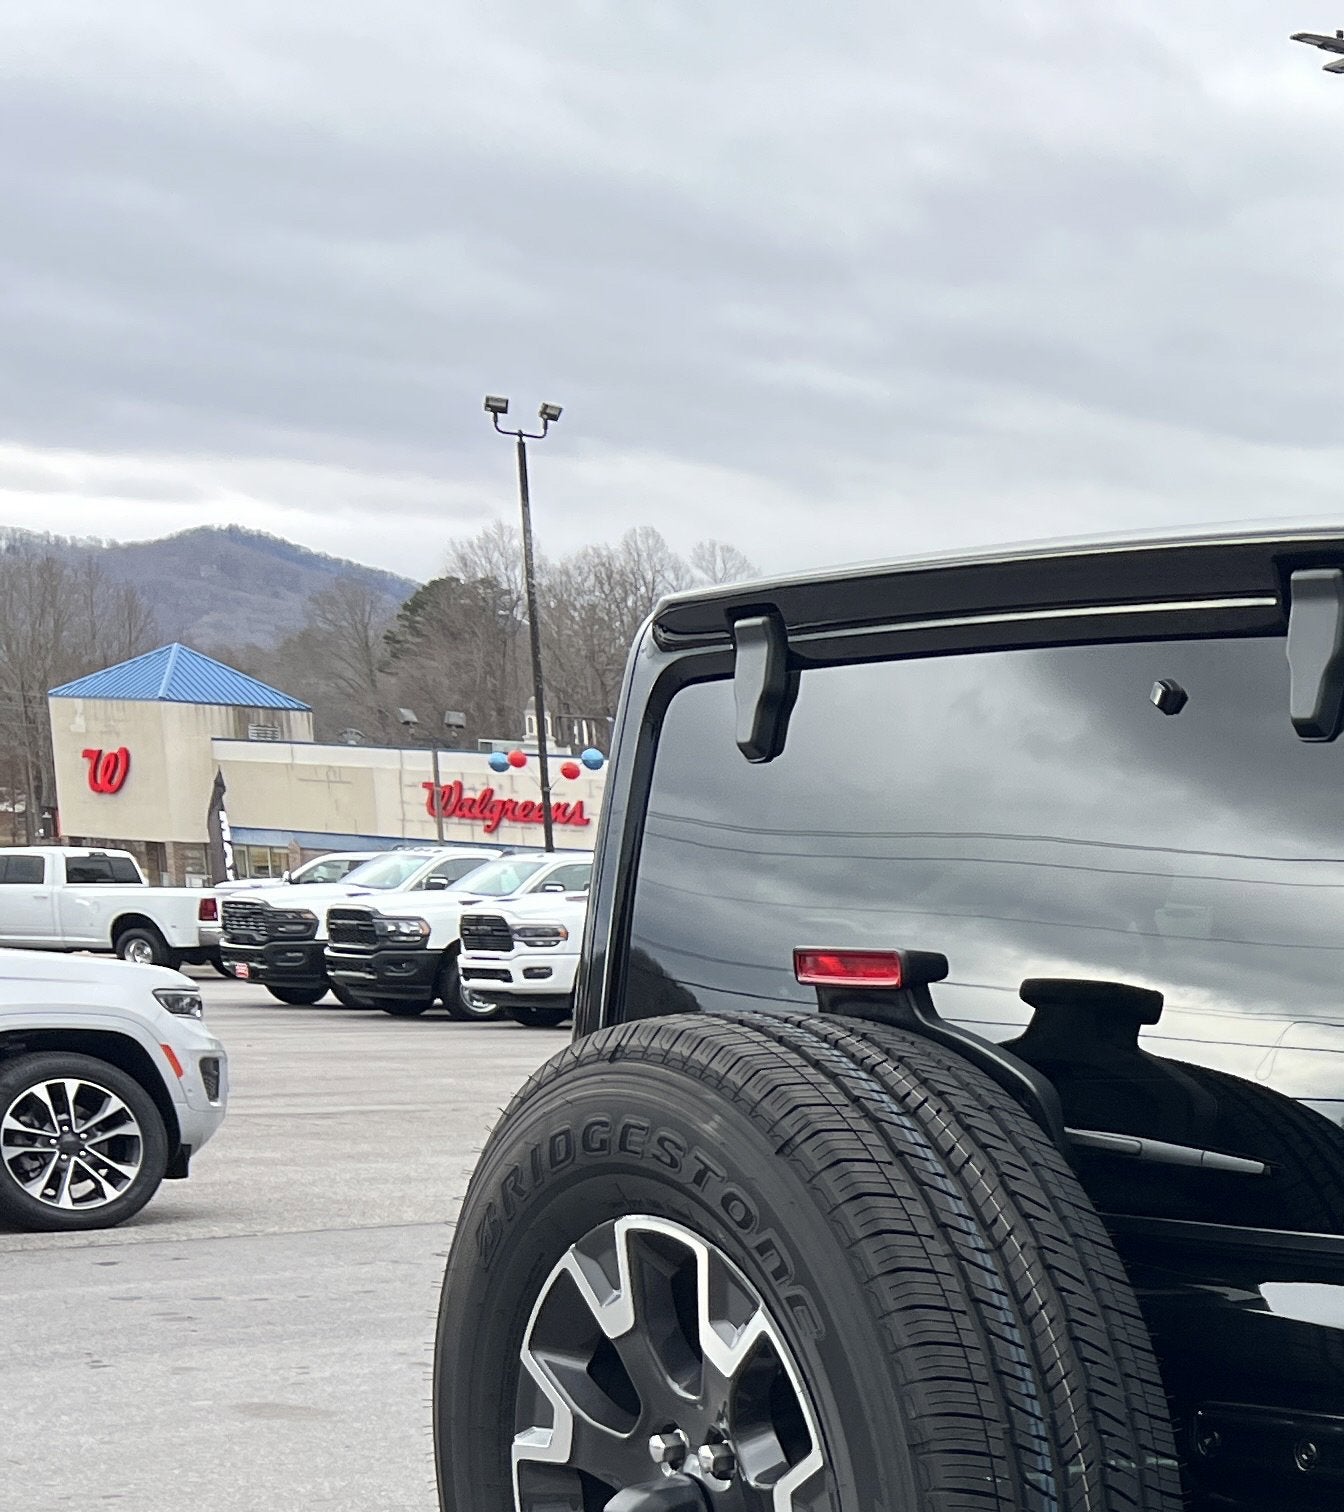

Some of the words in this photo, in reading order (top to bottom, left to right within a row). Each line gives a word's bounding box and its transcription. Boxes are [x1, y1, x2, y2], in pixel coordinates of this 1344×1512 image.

[81, 747, 130, 794] W
[422, 780, 590, 833] Walgreens
[476, 1111, 826, 1340] BRIDGESTONE
